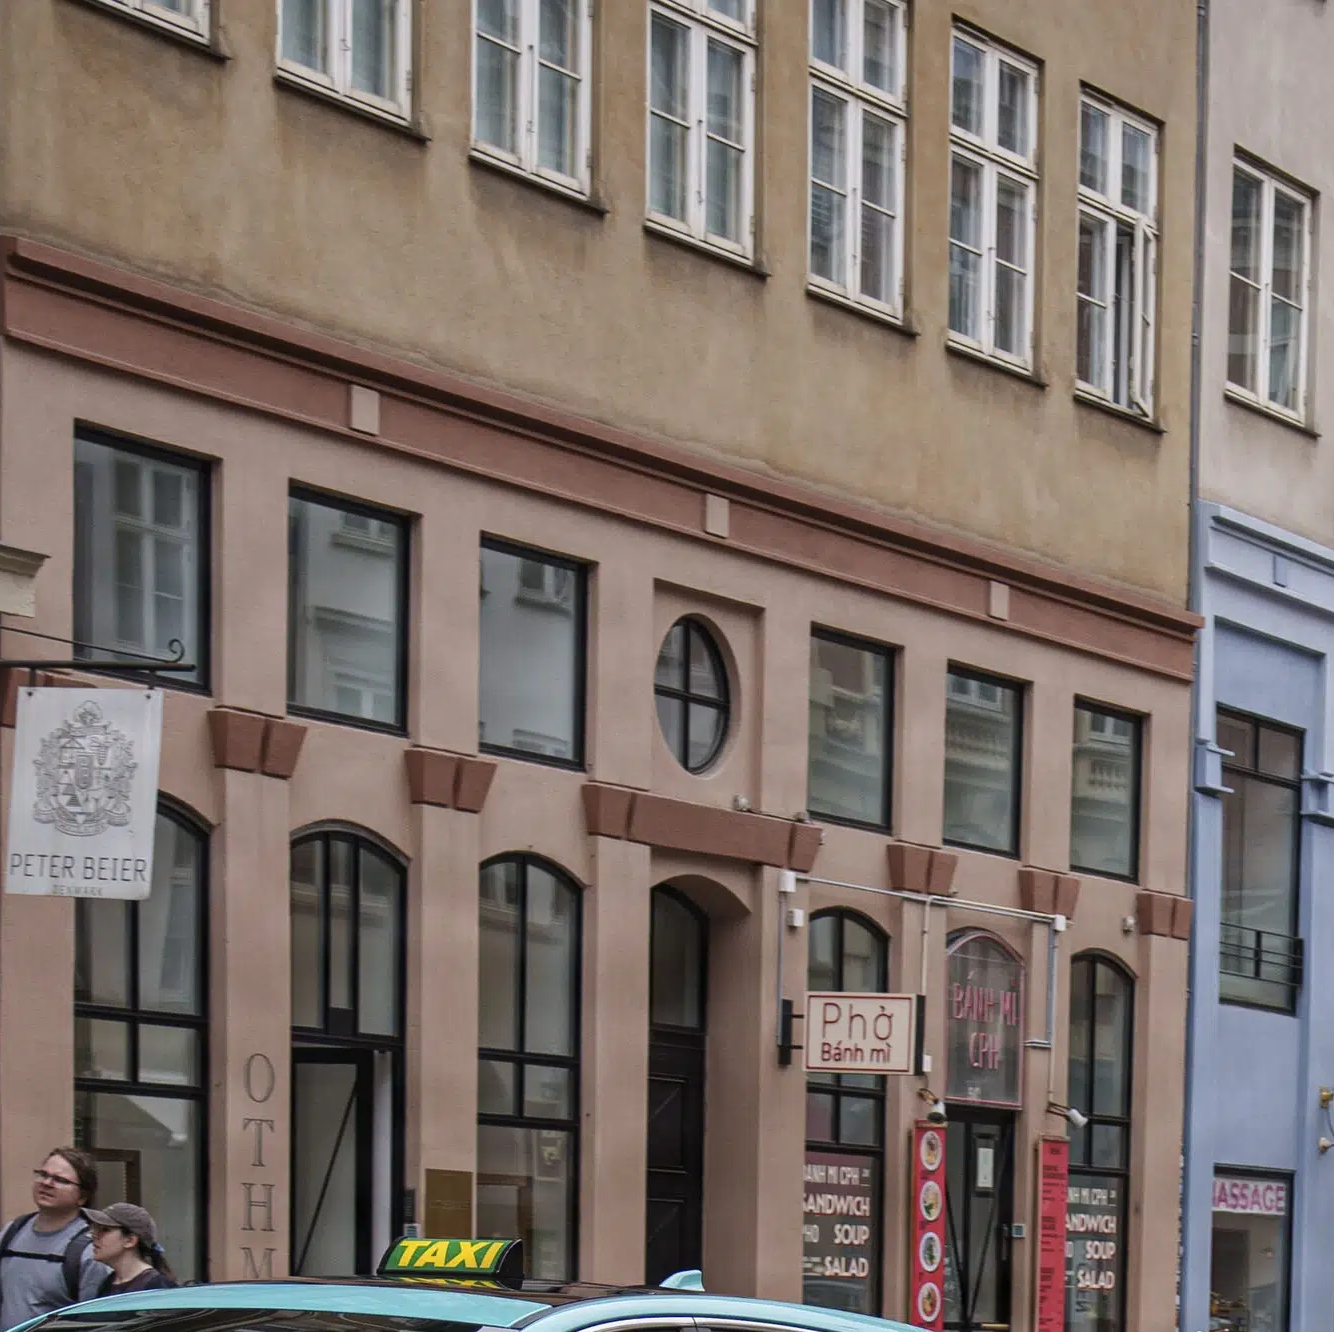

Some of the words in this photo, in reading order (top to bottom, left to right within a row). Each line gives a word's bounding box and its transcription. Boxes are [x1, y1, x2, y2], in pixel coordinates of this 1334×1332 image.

[10, 853, 75, 879] PETER
[82, 856, 148, 882] BEIER
[821, 1040, 864, 1063] Bánh
[870, 1043, 893, 1063] mì
[969, 1032, 999, 1069] CPH
[1212, 1180, 1284, 1212] ASSAGE
[1065, 1212, 1117, 1233] ANDWICH
[803, 1224, 819, 1243] HO
[834, 1224, 870, 1245] SOUP
[398, 1241, 505, 1269] TAXI
[1086, 1241, 1117, 1260] SOUP
[824, 1256, 869, 1278] SALAD
[1078, 1270, 1116, 1289] SALAD
